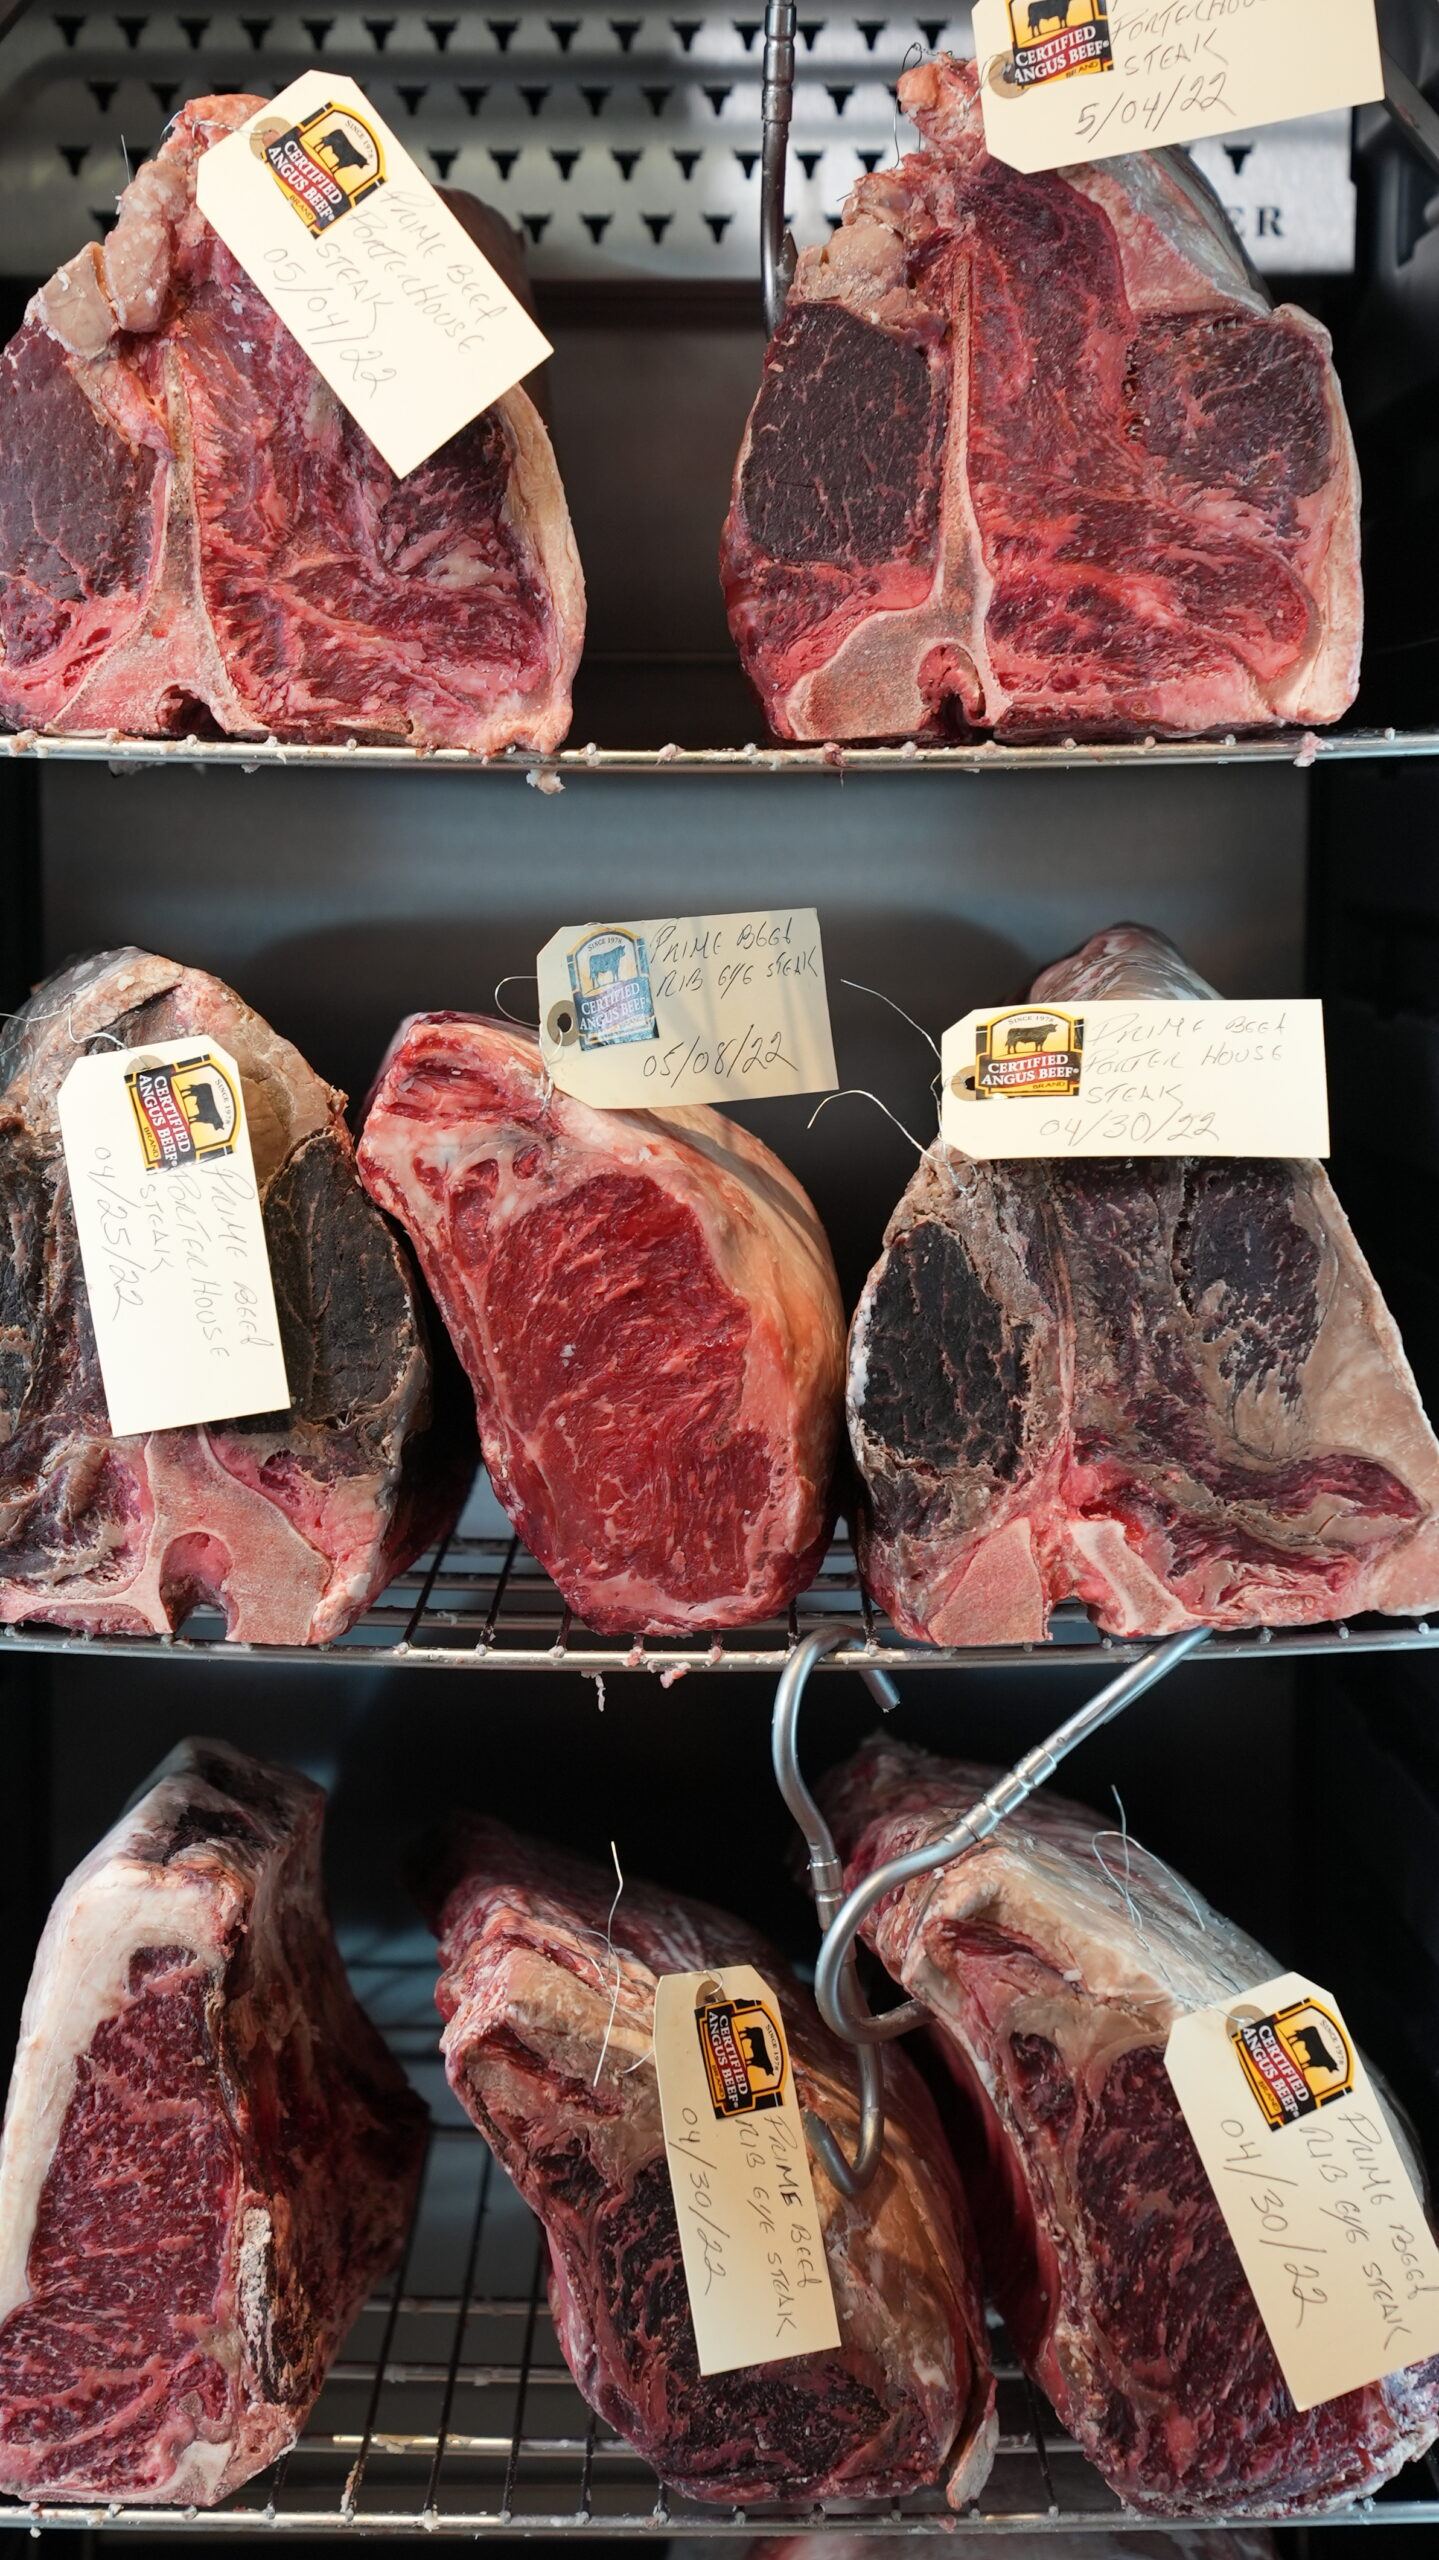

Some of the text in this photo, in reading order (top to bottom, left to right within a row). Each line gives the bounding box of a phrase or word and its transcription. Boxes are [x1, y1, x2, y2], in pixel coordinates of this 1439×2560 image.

[1015, 54, 1066, 83] ANGUS
[1016, 26, 1096, 66] CERTIFIED
[1124, 28, 1229, 76] STEAK
[1075, 72, 1237, 143] 5/04/22
[268, 147, 309, 191] ANGUS
[284, 140, 342, 204] CERTIFIED
[289, 195, 313, 220] BRAND
[380, 190, 446, 258] PRIME
[316, 242, 394, 333] STEAK
[264, 249, 396, 398] 05/04/22
[588, 938, 605, 951] SINCE
[650, 919, 722, 963] PRIME
[656, 968, 704, 997] RIB
[766, 945, 818, 977] STEAK
[580, 1007, 619, 1031] ANGUS
[581, 983, 640, 1015] CERTIFIED
[1008, 1016, 1032, 1025] SINCE
[1086, 1013, 1205, 1046] PRIME
[1201, 1043, 1282, 1066] HOUSE
[643, 1024, 798, 1088] 05/08/22
[981, 1070, 1035, 1085] ANGUS
[988, 1054, 1068, 1073] CERTIFIED
[139, 1074, 166, 1126] ANGUS
[215, 1079, 230, 1104] SINCE
[1032, 1081, 1066, 1089] BRAND
[1086, 1083, 1183, 1105] STEAK
[154, 1076, 190, 1152] CERTIFIED
[1040, 1107, 1220, 1147] 04/30/22
[144, 1126, 159, 1158] BRAND
[87, 1147, 146, 1321] 04/25/22
[140, 1183, 174, 1273] STEAK
[200, 1166, 255, 1258] PRIME
[168, 1170, 230, 1357] PORTER HOUSE
[709, 2011, 728, 2066] ANGUS
[720, 2014, 748, 2095] CERTIFIED
[765, 2024, 777, 2048] SINCE
[1243, 2027, 1278, 2079] ANGUS
[712, 2065, 724, 2097] BRAND
[1258, 2025, 1309, 2101] CERTIFIED
[1258, 2081, 1279, 2112] BRAND
[763, 2115, 804, 2207] PRIME
[1338, 2112, 1395, 2205] PRIME
[668, 2107, 730, 2296] 04/30/22
[1220, 2119, 1328, 2328] 04/30/22
[735, 2119, 766, 2168] RIB
[768, 2252, 797, 2337] STEAK
[1299, 2126, 1348, 2183] RIB
[1362, 2262, 1412, 2350] STEAK
